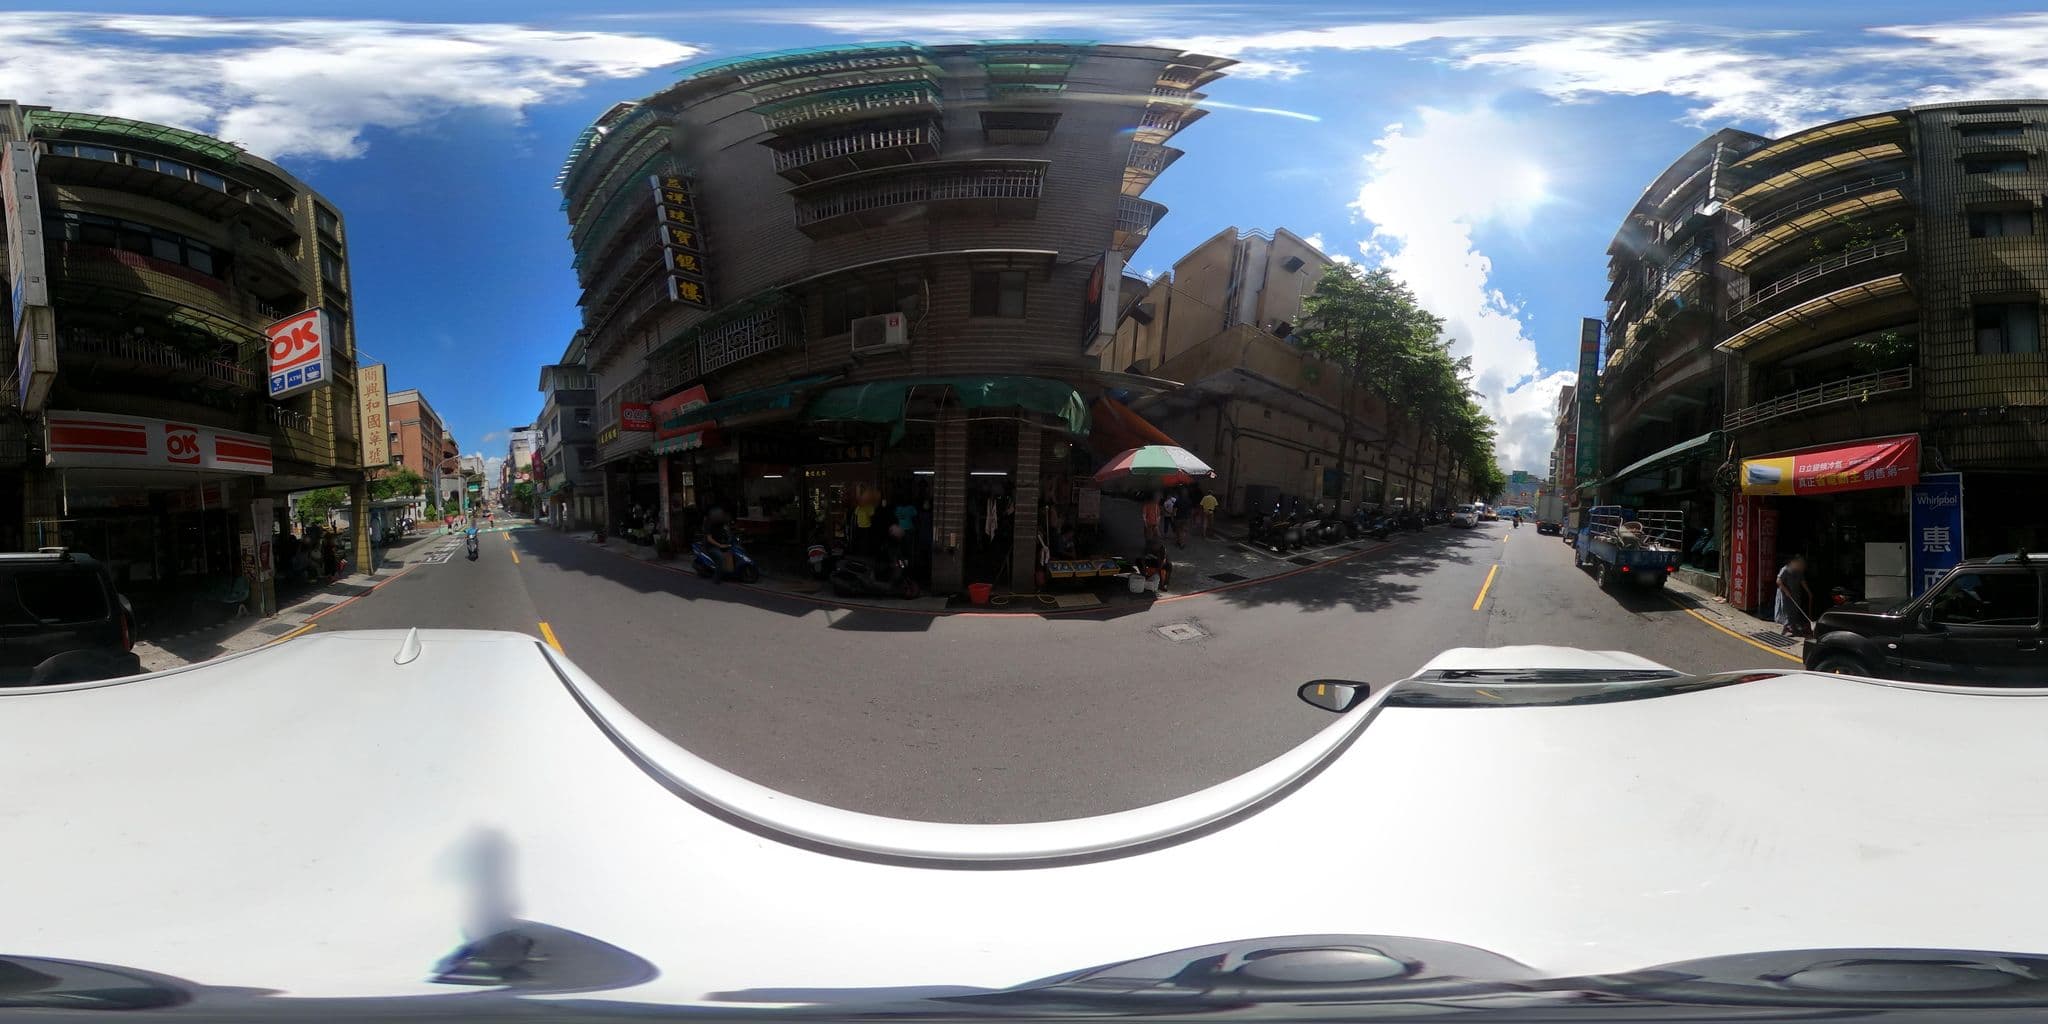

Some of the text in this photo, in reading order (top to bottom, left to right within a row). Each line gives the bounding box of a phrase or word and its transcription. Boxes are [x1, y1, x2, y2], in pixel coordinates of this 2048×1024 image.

[270, 321, 319, 360] OK
[288, 374, 302, 384] ATM
[167, 434, 199, 455] OK
[1917, 495, 1957, 507] Whirlpool
